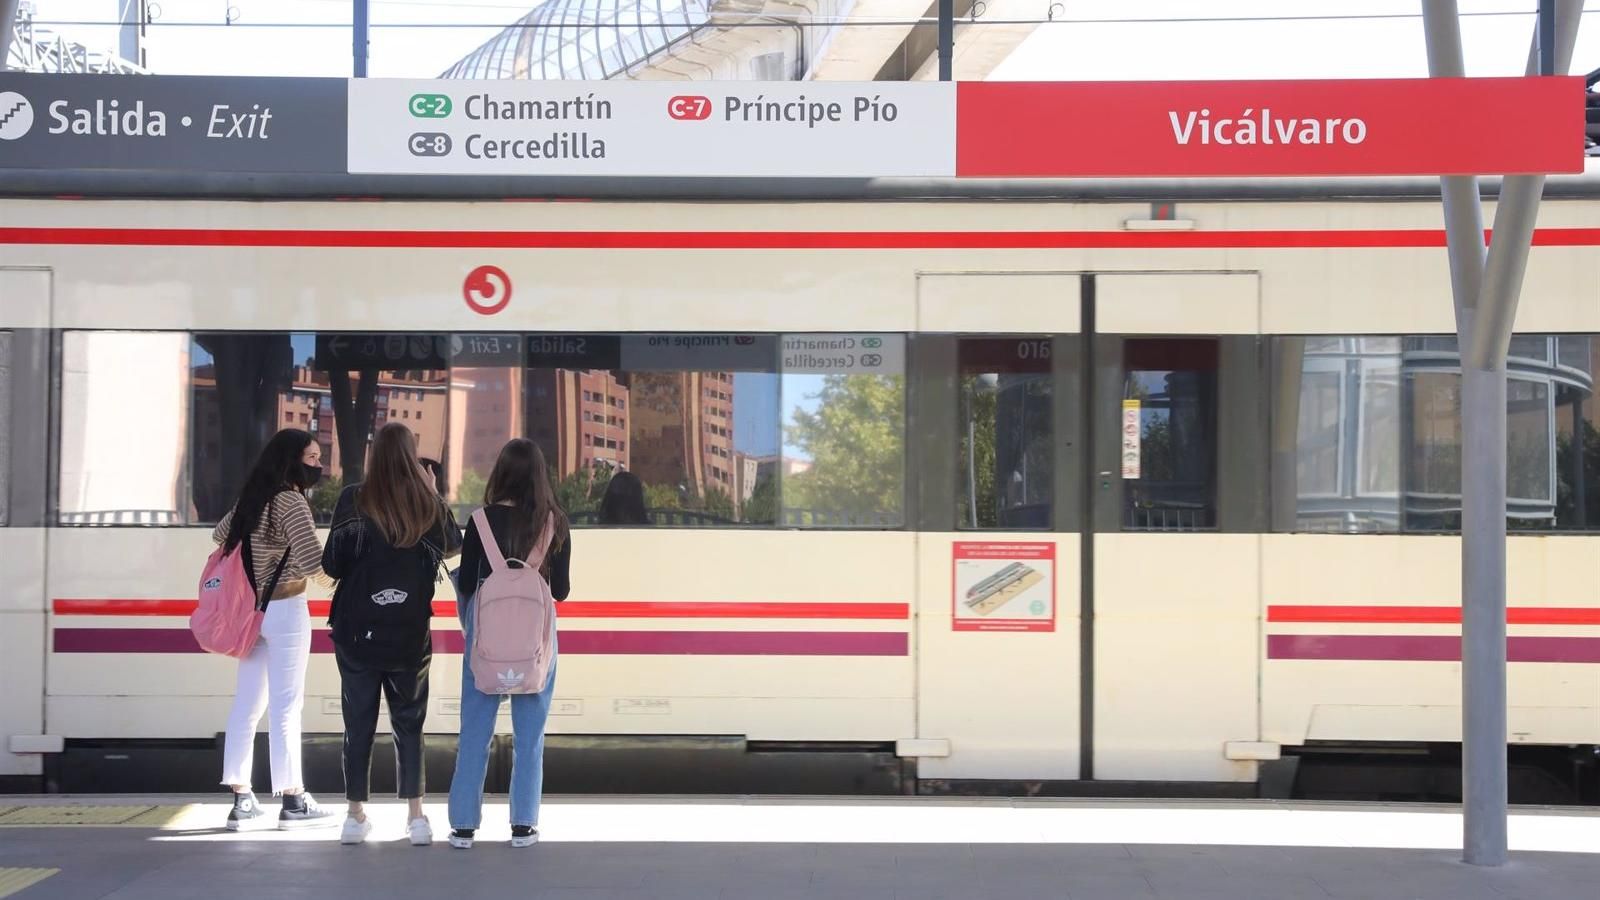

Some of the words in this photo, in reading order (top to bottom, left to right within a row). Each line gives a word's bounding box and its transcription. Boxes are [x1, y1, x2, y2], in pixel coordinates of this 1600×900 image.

[48, 99, 167, 137] Salida
[206, 103, 273, 139] Exit
[412, 97, 447, 115] C-2
[464, 92, 612, 120] Chamartín
[673, 99, 707, 117] C-7
[725, 94, 842, 128] Príncipe
[854, 94, 898, 122] Pío
[1168, 108, 1367, 145] Vicálvaro
[411, 135, 447, 154] C-8
[465, 132, 606, 160] Cercedilla
